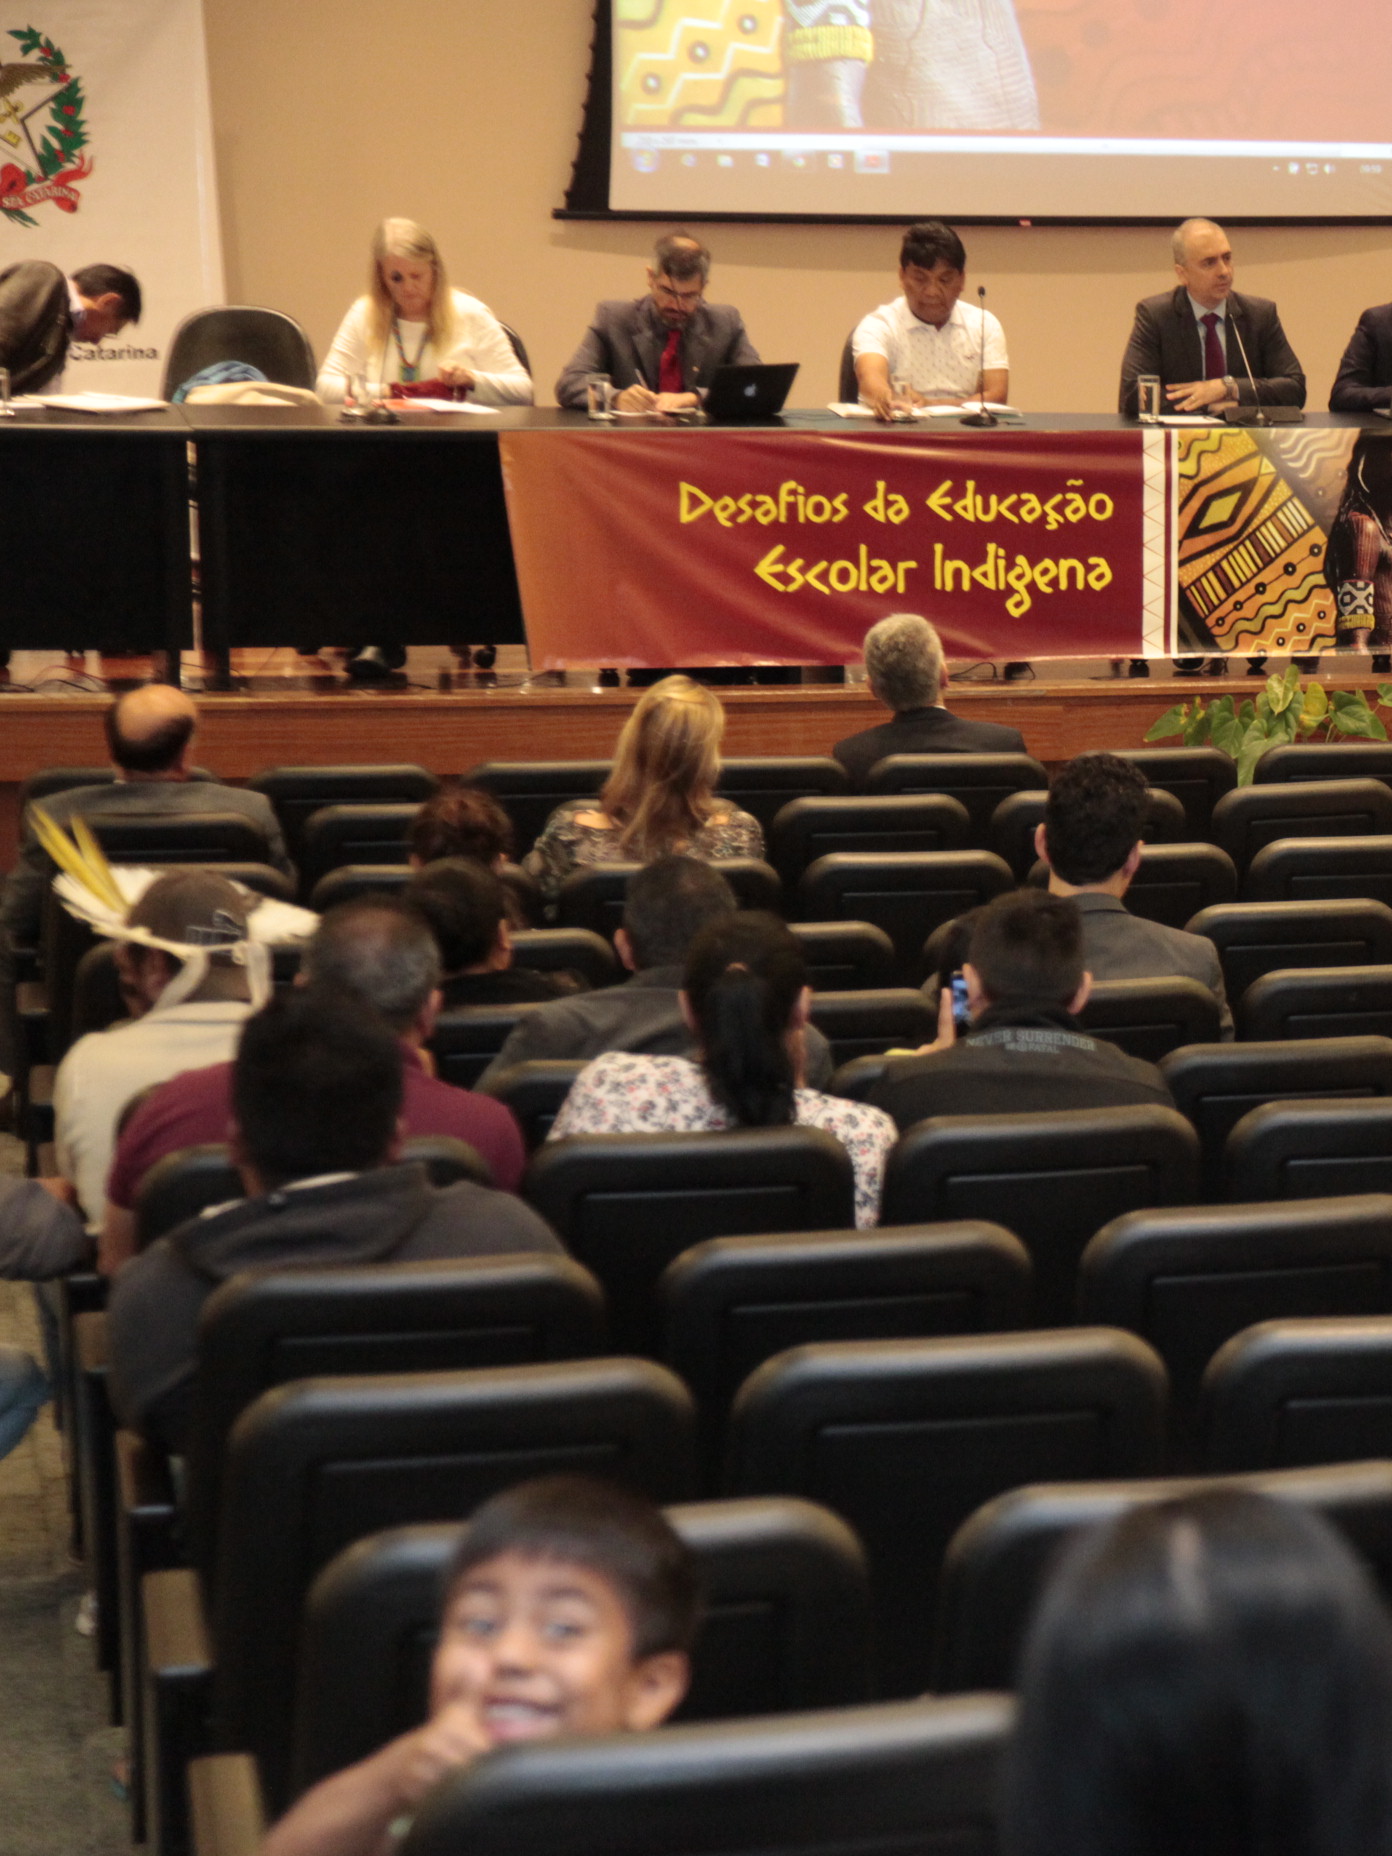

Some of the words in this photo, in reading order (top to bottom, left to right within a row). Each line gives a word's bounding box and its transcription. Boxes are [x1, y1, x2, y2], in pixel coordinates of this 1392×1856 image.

[69, 343, 158, 361] Catarina
[679, 480, 849, 528] Desafios
[863, 480, 911, 525] da
[925, 479, 1114, 531] Educação
[753, 543, 918, 595] Escolar
[935, 542, 1112, 618] Indigena
[966, 1029, 1012, 1048] NEVER
[1016, 1029, 1096, 1051] SURRENDER
